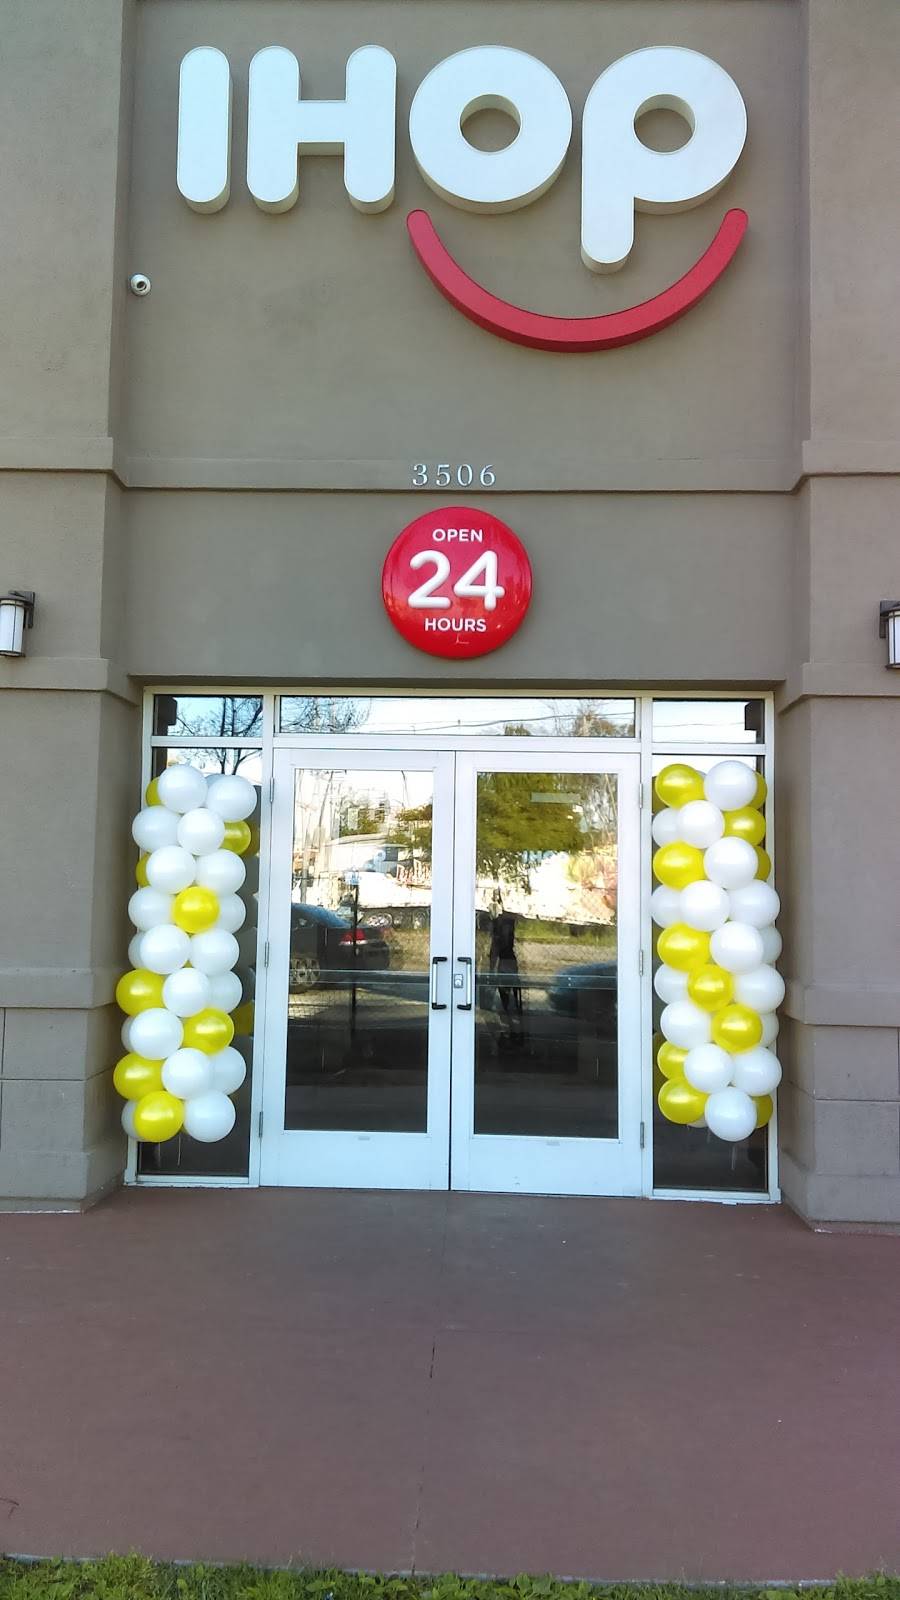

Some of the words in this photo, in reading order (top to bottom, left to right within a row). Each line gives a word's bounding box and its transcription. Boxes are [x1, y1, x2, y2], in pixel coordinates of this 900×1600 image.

[412, 463, 496, 487] 3506
[432, 528, 483, 543] OPEN
[407, 549, 505, 611] 24
[424, 617, 487, 632] HOURS
